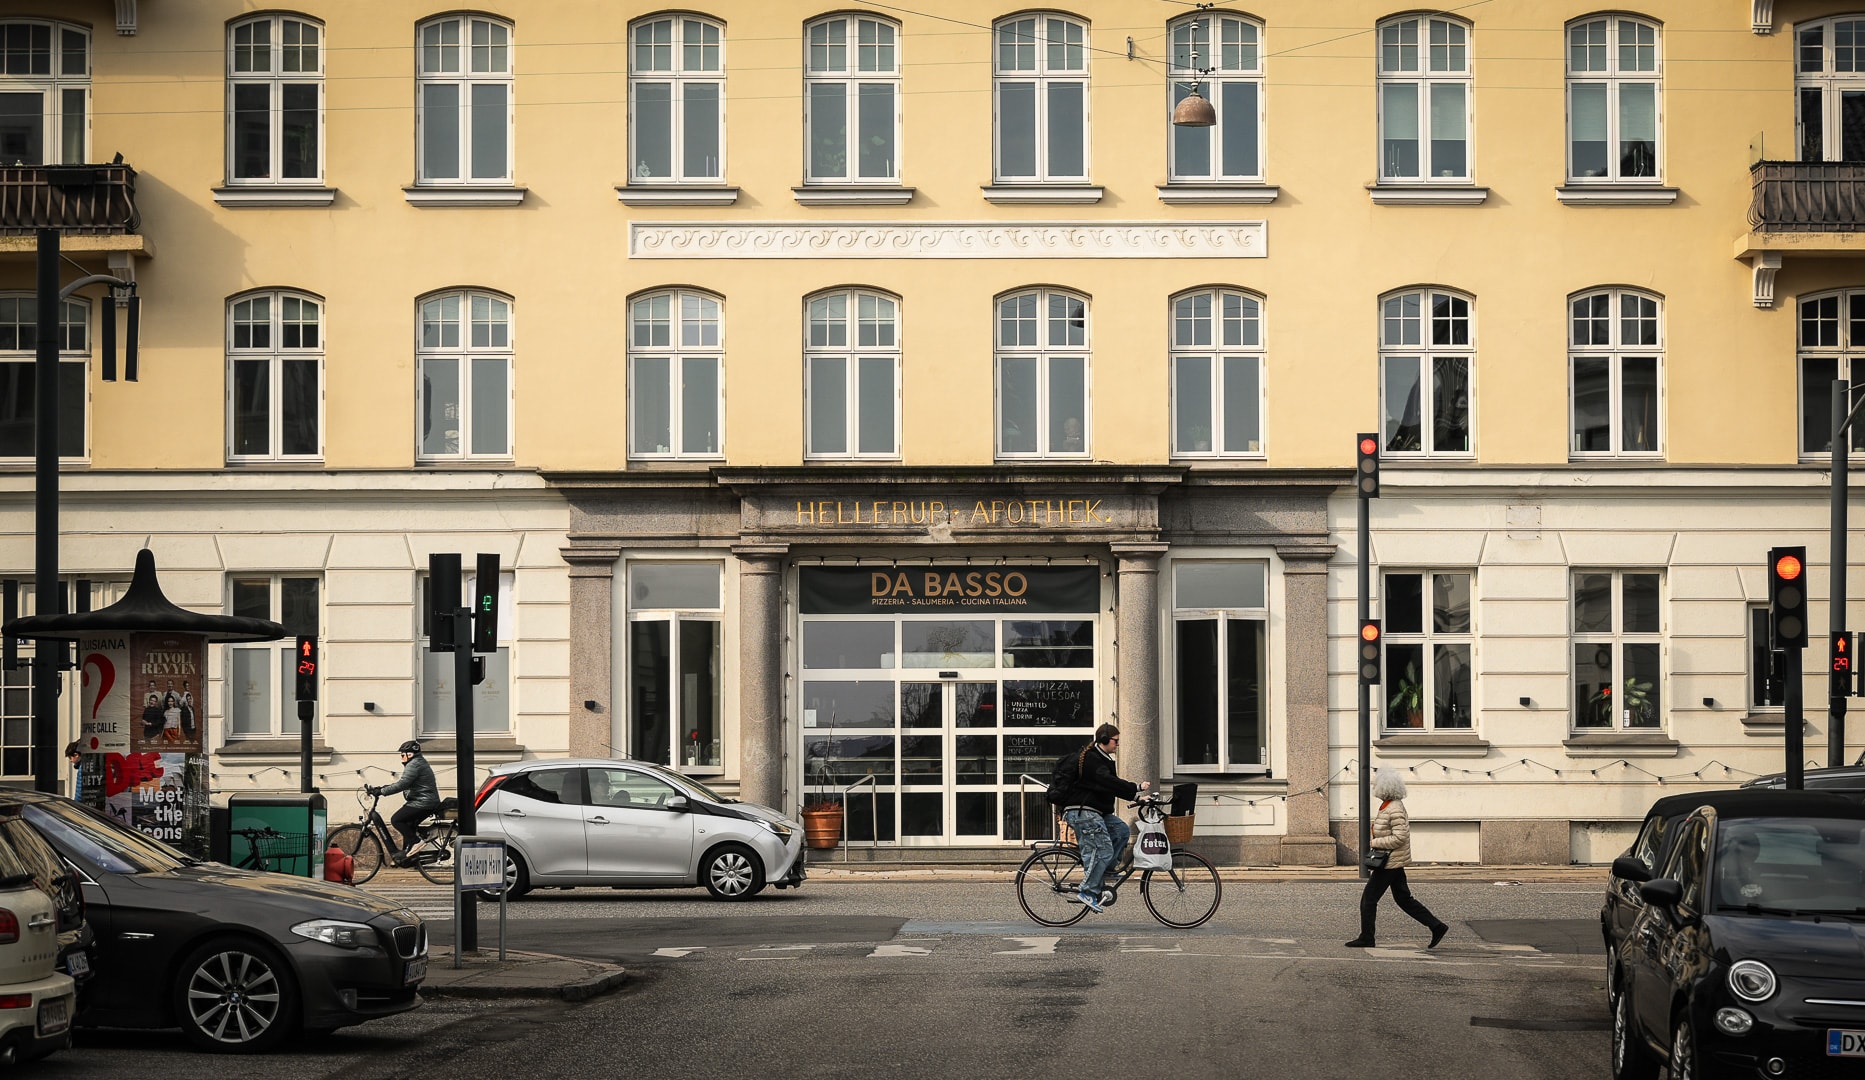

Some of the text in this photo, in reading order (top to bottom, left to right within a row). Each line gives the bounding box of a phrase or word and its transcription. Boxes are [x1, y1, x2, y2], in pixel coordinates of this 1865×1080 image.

[796, 500, 944, 525] HELLERUP
[871, 572, 1028, 597] DA BASSO
[871, 598, 1027, 606] PIZZERIA SALUMERIA CUCINA ITALIANA
[146, 652, 193, 664] TIVOLI
[1833, 657, 1849, 671] 29
[141, 663, 196, 675] REVYEN
[298, 660, 316, 675] 29
[1039, 681, 1070, 691] PIZZA
[1036, 691, 1081, 700] TUESDAY
[1011, 701, 1048, 709] UNLIMITED
[96, 722, 117, 733] CALLE
[1011, 737, 1035, 746] OPEN
[139, 786, 184, 803] Meet
[154, 805, 183, 822] the
[464, 853, 502, 879] Hellerup Havn
